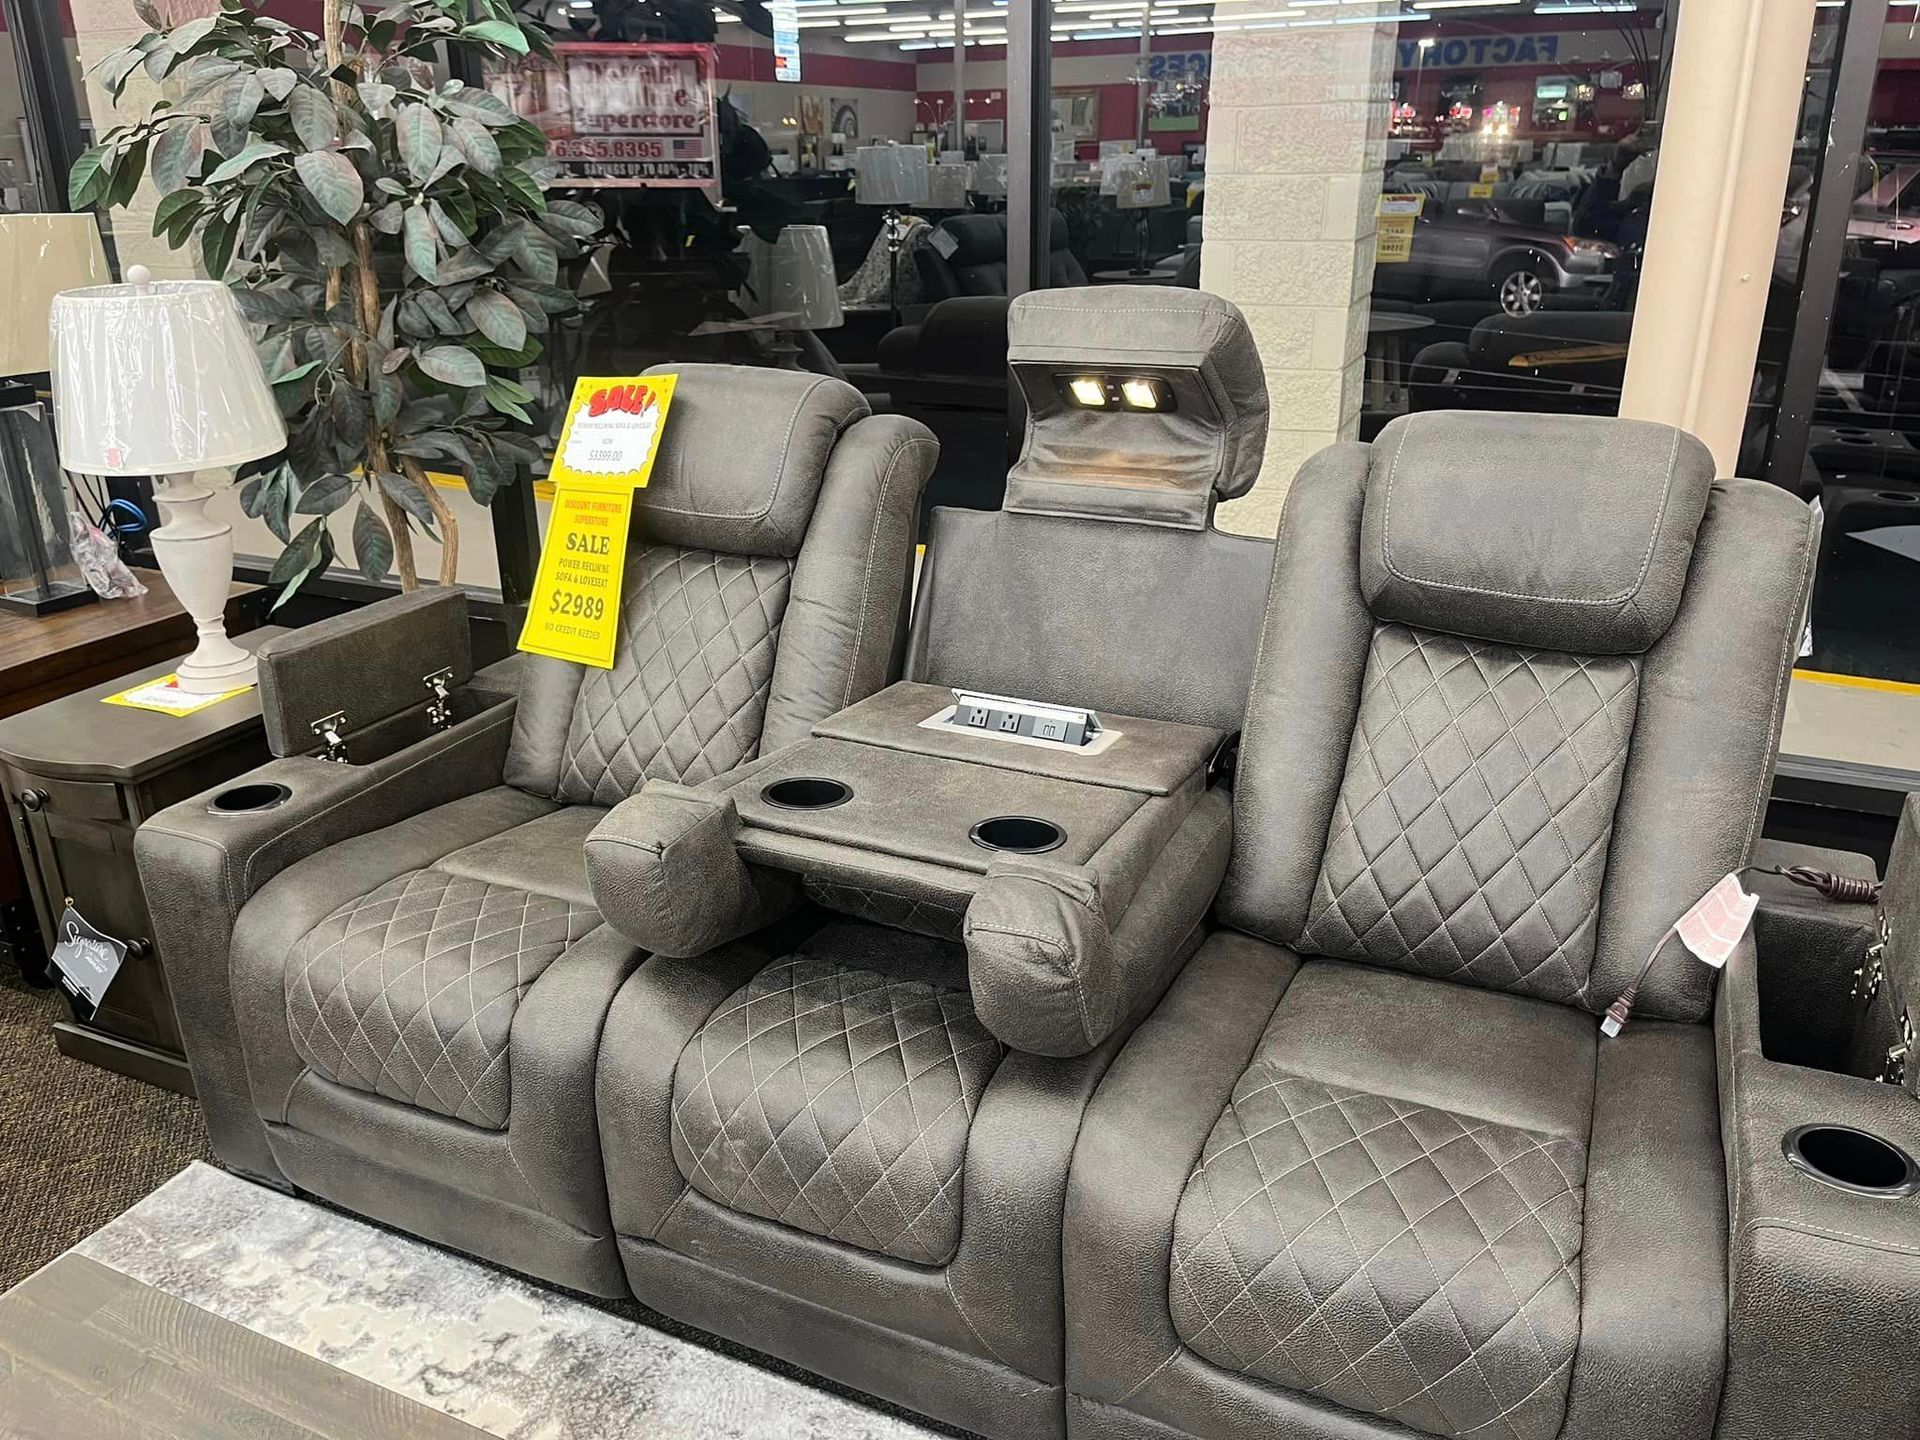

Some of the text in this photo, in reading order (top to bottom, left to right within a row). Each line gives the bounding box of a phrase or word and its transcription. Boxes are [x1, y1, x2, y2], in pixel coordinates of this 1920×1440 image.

[628, 163, 640, 175] UP
[643, 163, 655, 175] TO
[588, 384, 657, 418] SALE!
[566, 532, 610, 556] SALE
[558, 558, 610, 574] POWER RECLINING
[555, 571, 609, 588] SOFA & LOVESEAT
[549, 588, 604, 621] $2989
[544, 622, 601, 640] NO CREDIT NEEDED
[64, 920, 109, 961] Signature
